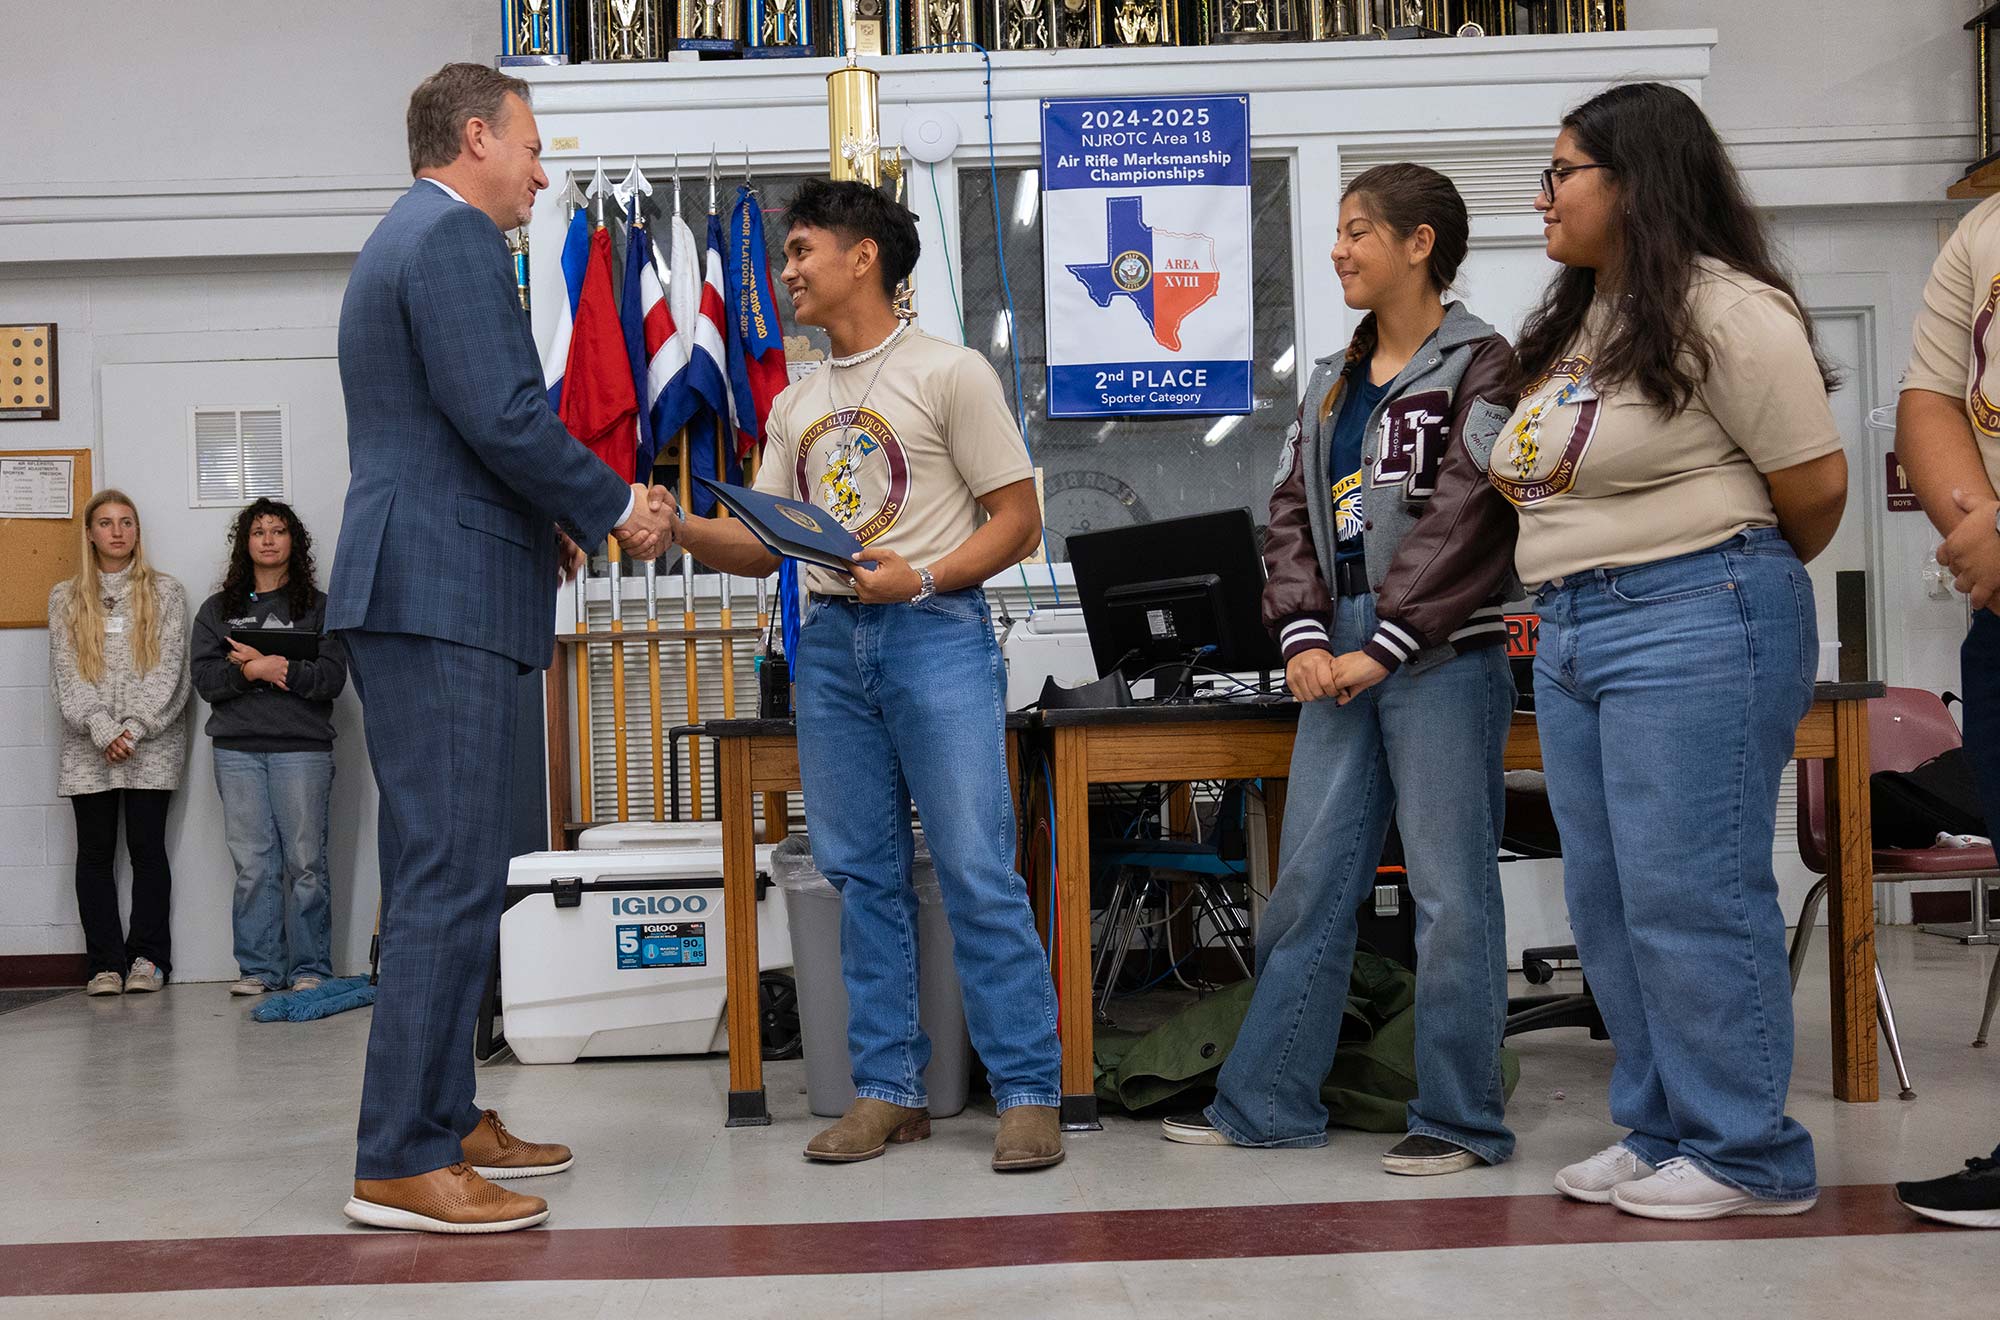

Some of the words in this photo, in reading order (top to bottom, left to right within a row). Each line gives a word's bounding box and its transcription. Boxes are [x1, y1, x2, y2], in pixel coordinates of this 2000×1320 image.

[1082, 108, 1210, 130] 2024-2025
[1082, 132, 1147, 147] NJROTC
[1152, 132, 1188, 146] Area
[1193, 131, 1211, 144] 18
[1057, 155, 1080, 168] Air
[1085, 153, 1118, 167] Rifle
[1124, 151, 1231, 166] Marksmanship
[1090, 167, 1205, 183] Championships
[741, 202, 751, 237] HONOR
[741, 239, 751, 286] PLATOON
[1165, 258, 1199, 270] AREA
[1164, 275, 1199, 288] XVIII
[750, 289, 768, 339] 2019-2020
[1095, 371, 1125, 390] 2nd
[1132, 369, 1207, 388] PLACE
[1101, 393, 1146, 406] Sporter
[1149, 391, 1202, 405] Category
[1484, 410, 1509, 424] NJRO
[800, 424, 824, 459] FLOUR
[858, 414, 892, 444] NJROTC
[1331, 478, 1357, 499] OUR
[1514, 487, 1526, 499] OF
[855, 501, 898, 542] AMPIONS
[612, 895, 708, 915] IGLOO
[643, 924, 678, 933] IGLOO
[618, 930, 639, 954] 5
[683, 939, 698, 948] 90
